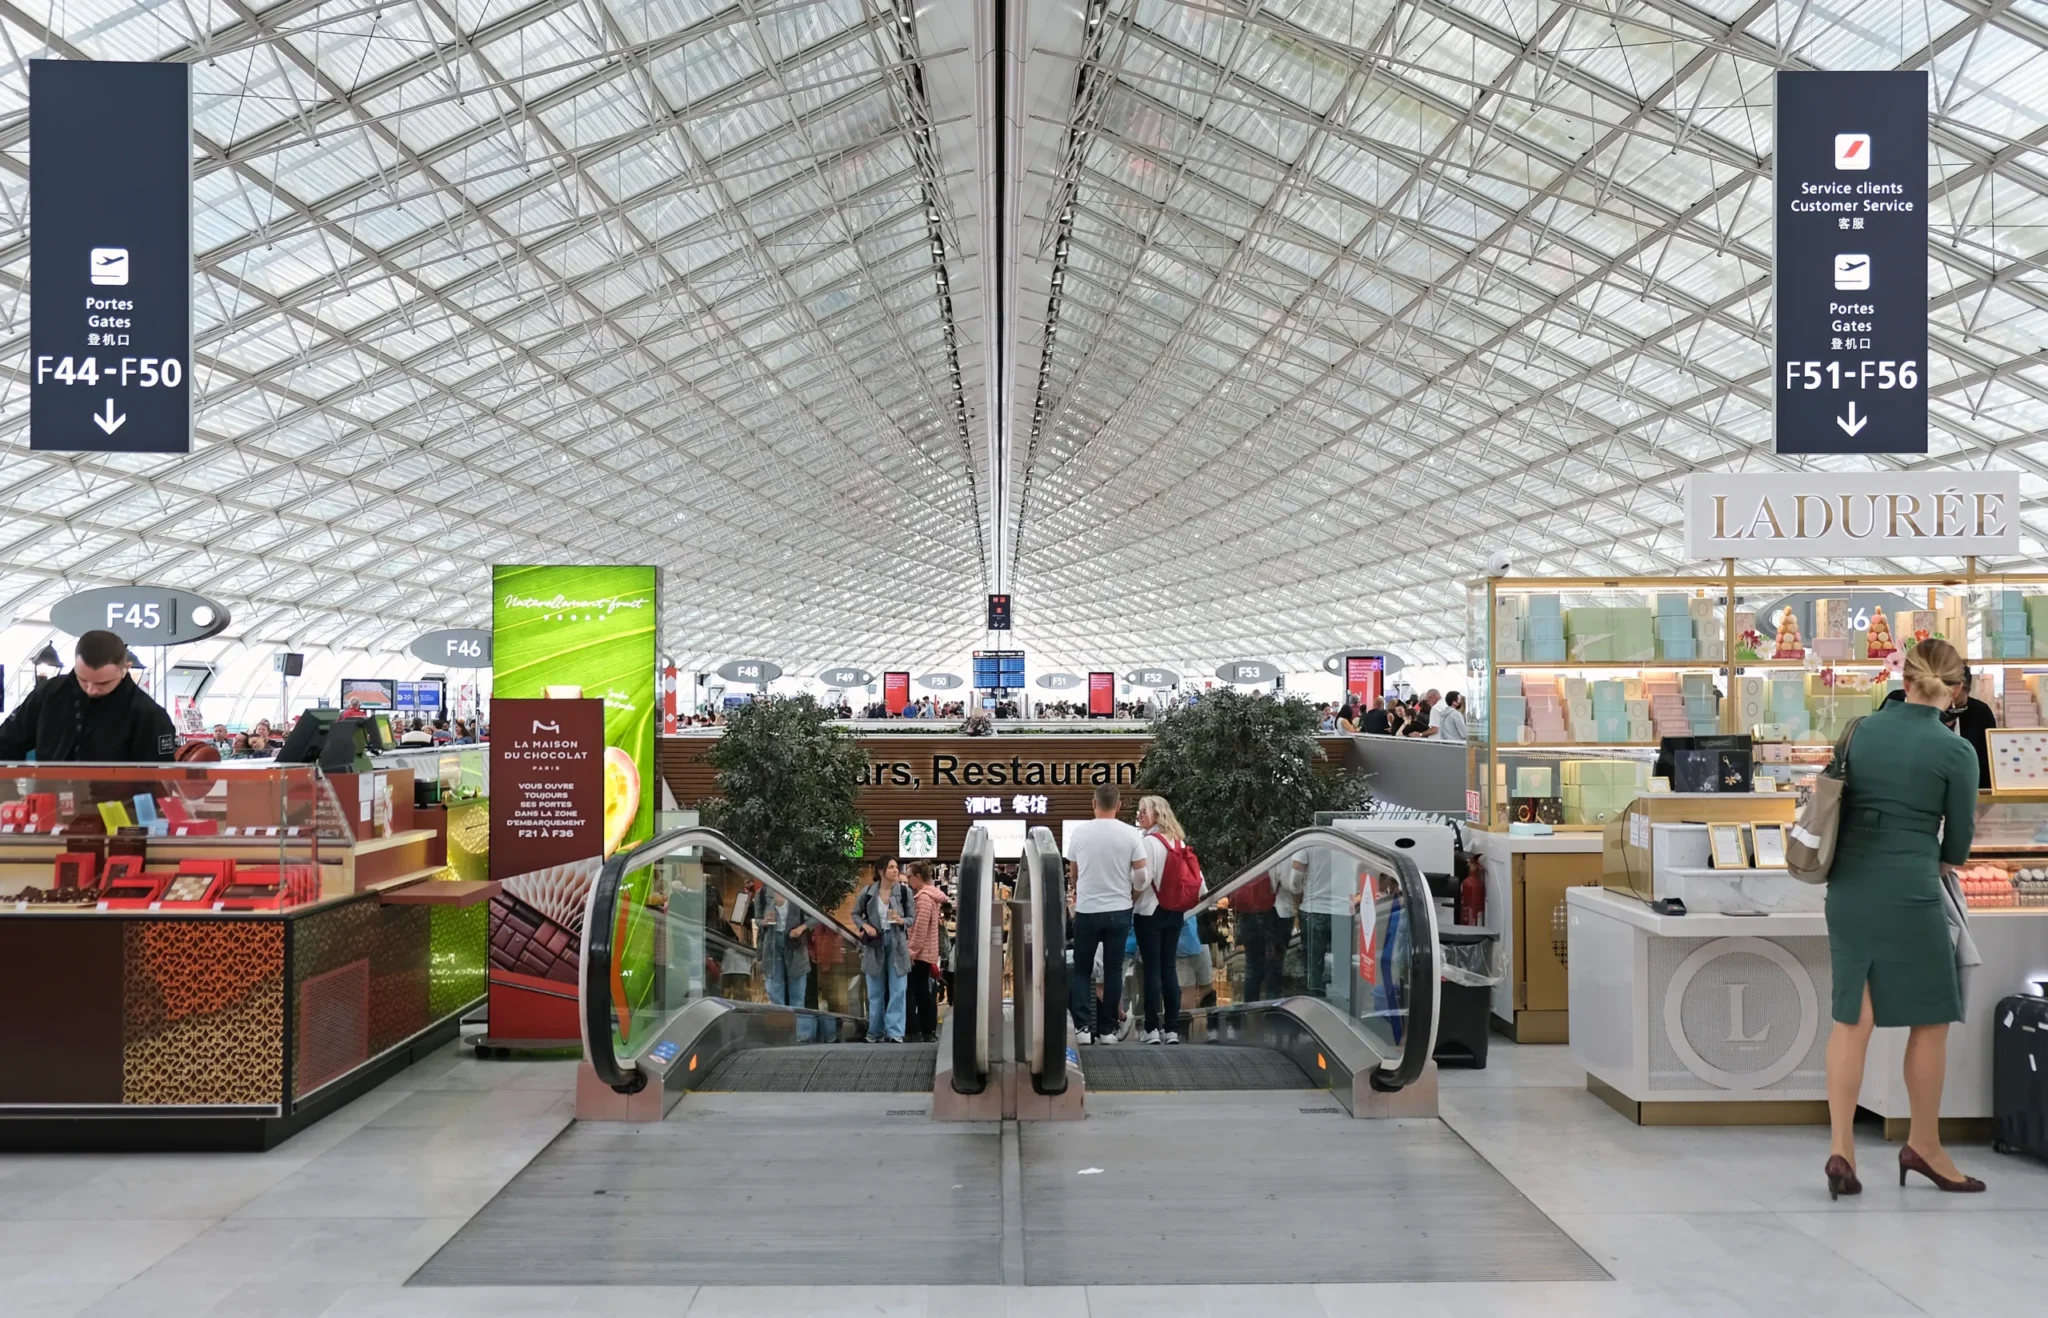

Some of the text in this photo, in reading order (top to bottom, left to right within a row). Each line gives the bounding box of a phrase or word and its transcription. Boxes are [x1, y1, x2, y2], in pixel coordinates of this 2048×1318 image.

[1801, 181, 1903, 194] Service clients
[1790, 199, 1914, 212] Customer Service
[1838, 217, 1865, 230] 客服
[86, 296, 134, 310] Portes
[1829, 302, 1875, 315] Portes
[88, 315, 132, 328] Gates
[1831, 320, 1873, 332] Gates
[87, 333, 130, 346] 登机口
[1830, 337, 1871, 350] 登机口
[1786, 360, 1918, 390] F51-F56
[1708, 487, 2008, 540] LADURÉE
[106, 603, 161, 629] F45
[446, 639, 482, 658] F46
[737, 666, 760, 678] F48
[836, 672, 855, 683] F49
[1144, 673, 1163, 683] F52
[1238, 666, 1260, 678] F53
[931, 676, 947, 686] F50
[1052, 676, 1067, 686] F51
[514, 740, 578, 749] LA MAISON
[504, 751, 588, 759] DU CHOCOLAT
[506, 819, 586, 827] D'EMBARQUEMENT
[518, 827, 574, 838] F21 À F36
[1722, 984, 1771, 1041] L
